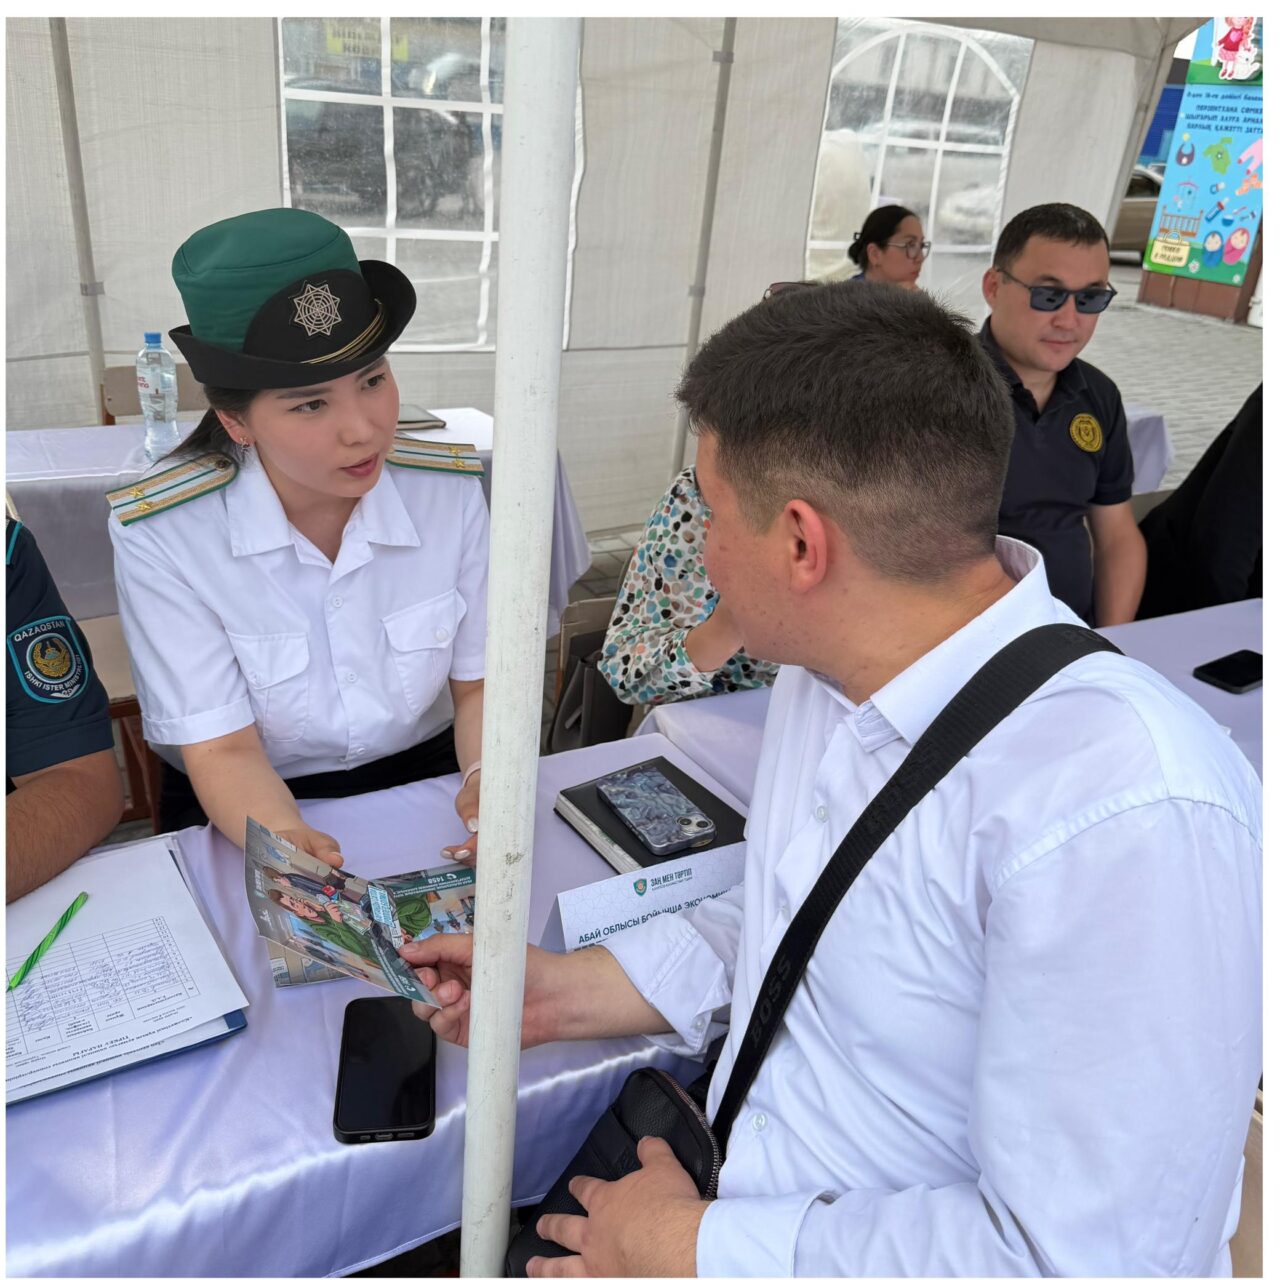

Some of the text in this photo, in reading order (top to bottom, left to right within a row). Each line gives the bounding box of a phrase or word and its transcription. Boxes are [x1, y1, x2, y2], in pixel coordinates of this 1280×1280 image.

[14, 620, 65, 642] QAZAQSTAN
[24, 670, 42, 688] ISHKI
[650, 877, 662, 888] ЗАҢ
[662, 873, 674, 885] МЕН
[578, 927, 602, 944] АБАЙ
[603, 917, 640, 936] ОБЛЫСЫ
[751, 953, 791, 1047] BOSS
